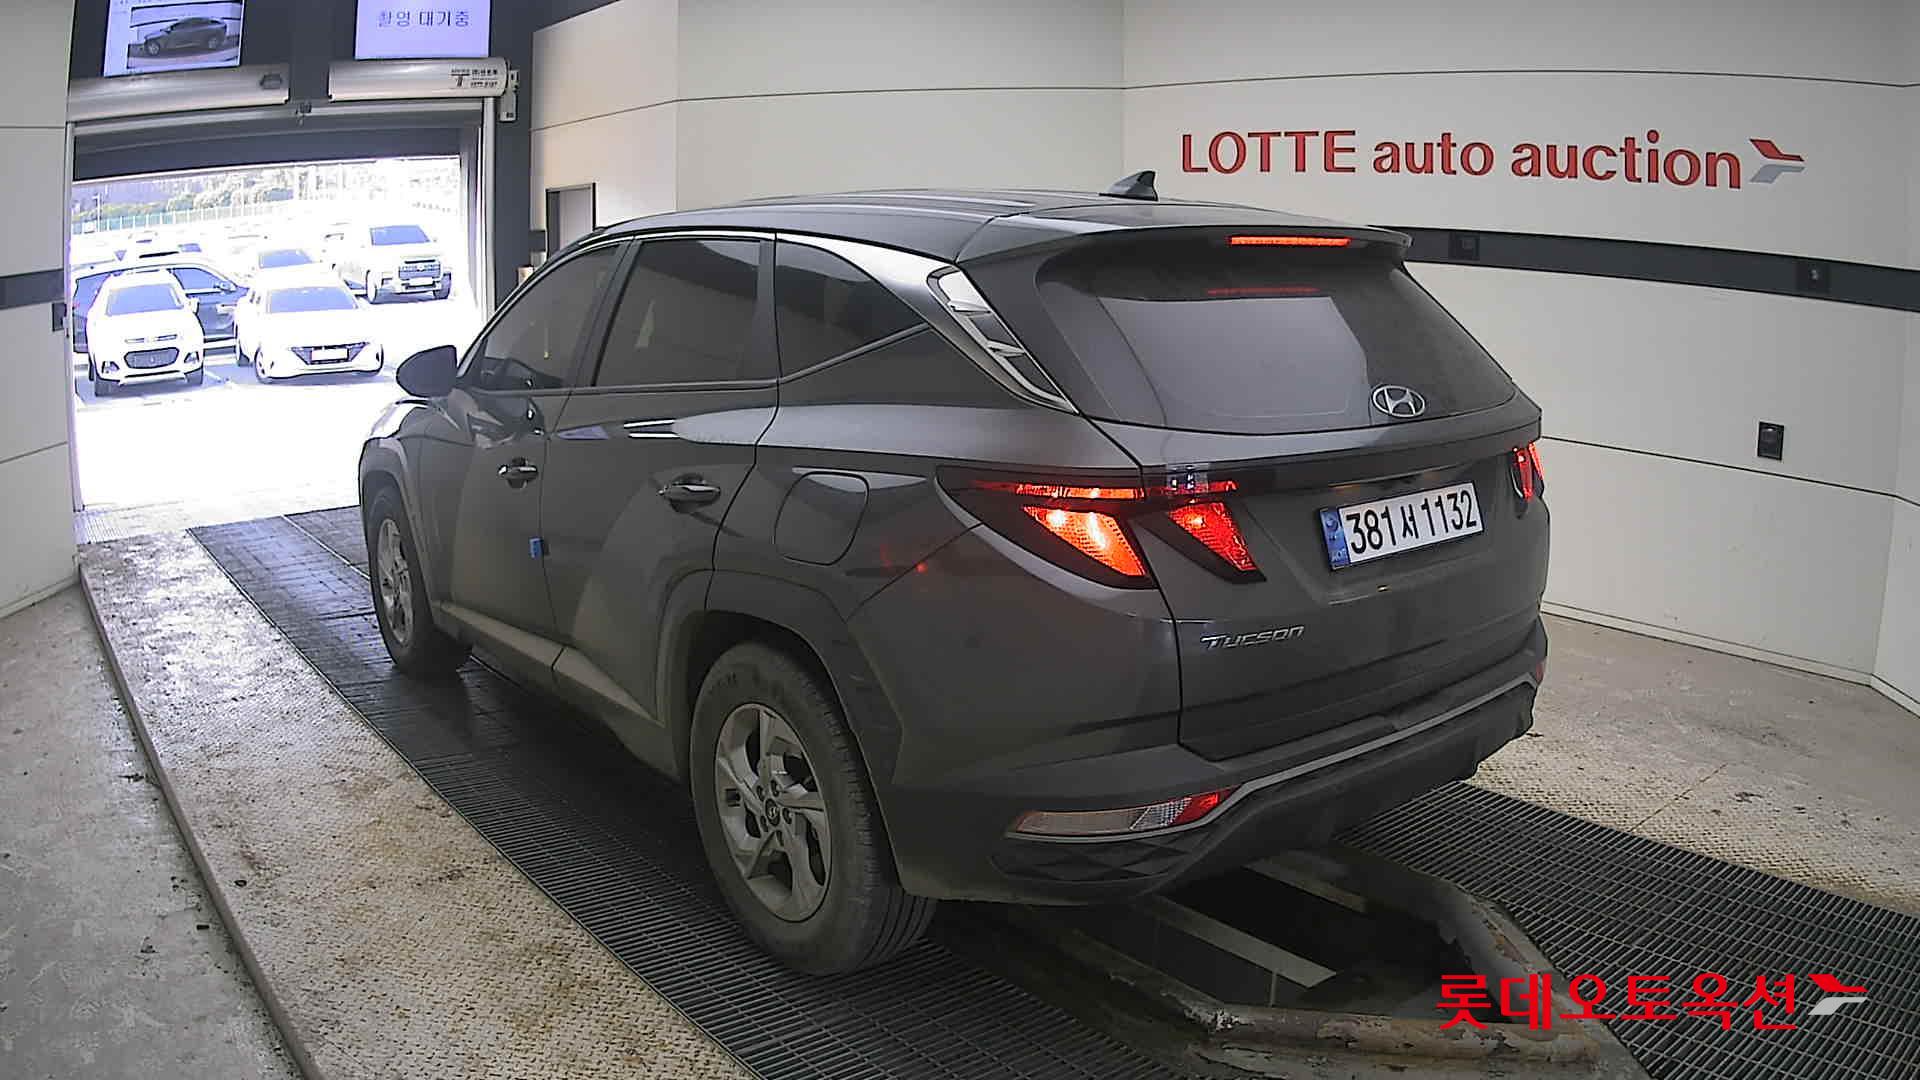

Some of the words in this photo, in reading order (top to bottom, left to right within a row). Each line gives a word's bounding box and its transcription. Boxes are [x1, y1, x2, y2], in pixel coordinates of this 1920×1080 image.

[419, 10, 469, 27] 대기중
[1182, 130, 1356, 174] LOTTE
[1373, 132, 1494, 176] auto
[1511, 129, 1741, 189] auction
